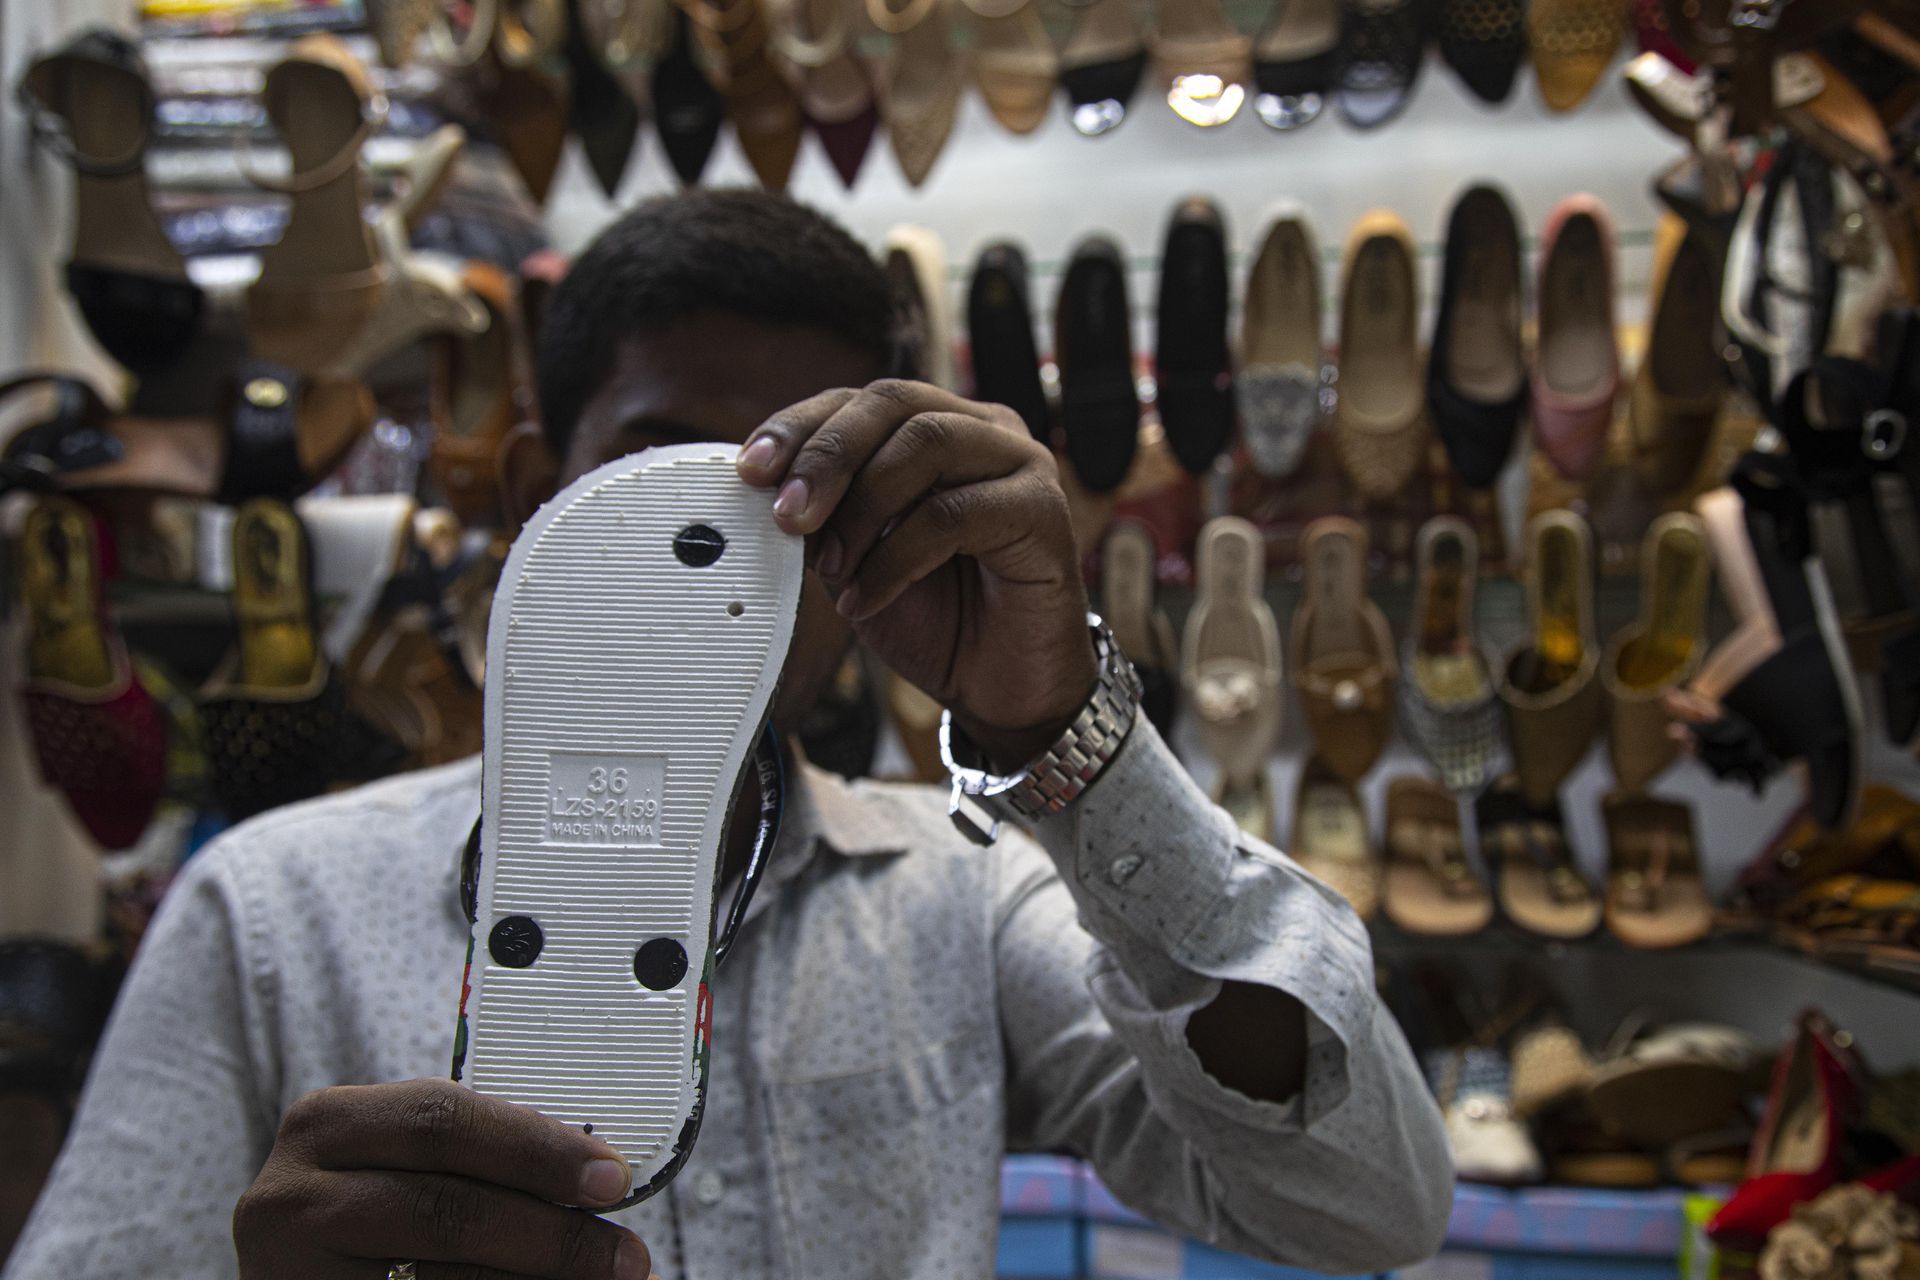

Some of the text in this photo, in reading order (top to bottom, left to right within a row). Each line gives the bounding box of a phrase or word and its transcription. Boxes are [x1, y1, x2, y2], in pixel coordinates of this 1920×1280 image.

[588, 766, 628, 794] 36
[551, 797, 658, 819] LZS-2159
[551, 822, 654, 838] MADE IN CHINA
